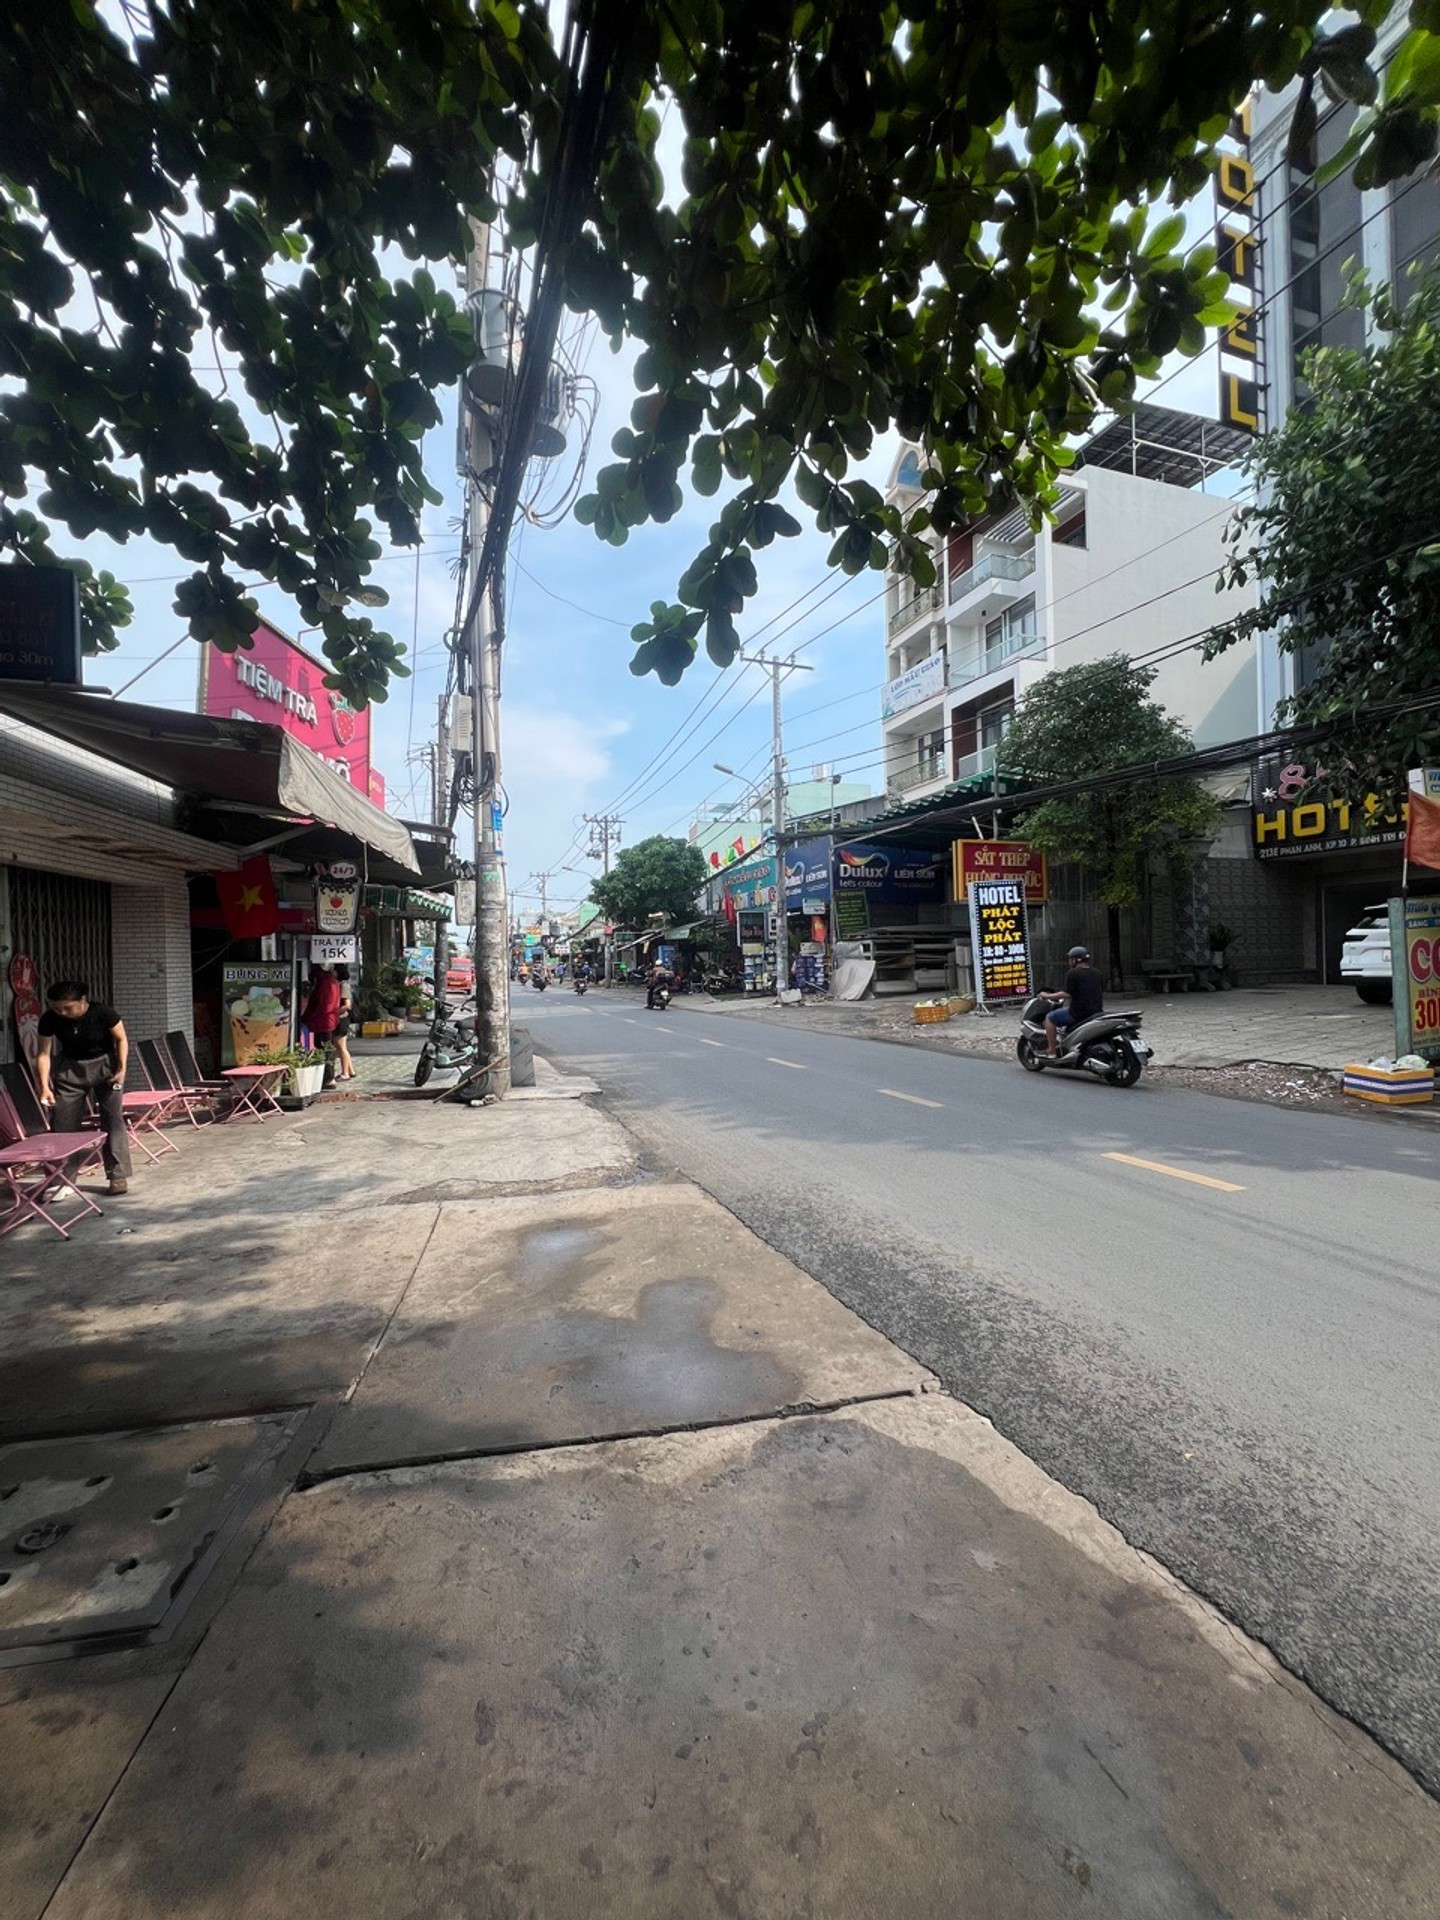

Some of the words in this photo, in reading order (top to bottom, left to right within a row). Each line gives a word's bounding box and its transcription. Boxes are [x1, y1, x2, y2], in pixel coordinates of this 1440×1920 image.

[235, 655, 283, 703] TIỆM
[284, 687, 318, 727] TRÀ
[1280, 845, 1301, 855] PHAN
[999, 849, 1030, 866] THÉP
[839, 863, 884, 878] Dulux
[978, 886, 1022, 906] HOTEL
[981, 905, 1020, 918] PHÁT
[988, 918, 1016, 932] LỘC
[983, 930, 1022, 943] PHÁT
[321, 948, 347, 958] 15K
[1415, 999, 1440, 1031] 30
